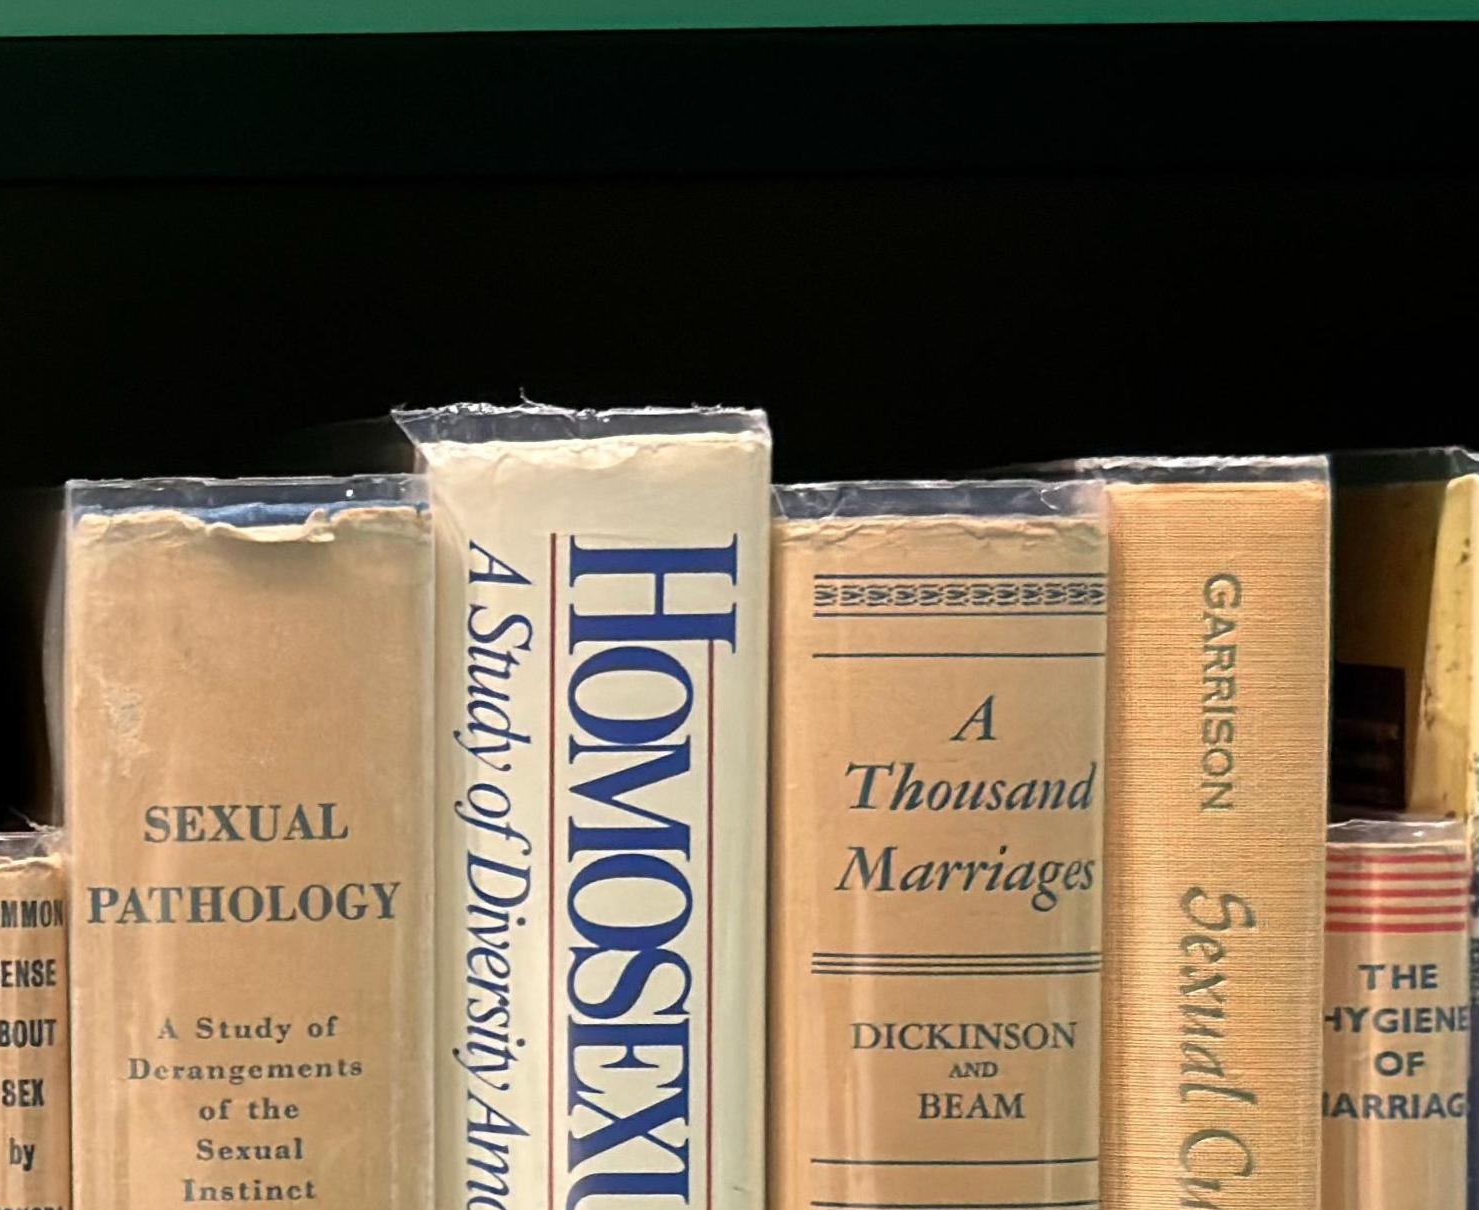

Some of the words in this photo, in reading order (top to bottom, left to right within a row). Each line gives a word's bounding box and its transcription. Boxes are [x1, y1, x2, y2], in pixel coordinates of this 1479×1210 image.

[453, 604, 533, 772] Study
[1199, 572, 1243, 814] GARRISON
[949, 694, 998, 742] A
[845, 761, 1097, 811] Thousand
[144, 802, 348, 843] SEXUAL
[834, 845, 1095, 912] Marriages
[87, 882, 400, 924] PATHOLOGY
[452, 850, 532, 1092] Diversity
[1357, 963, 1438, 991] THE
[1178, 884, 1259, 1105] Sexual
[157, 1018, 179, 1039] A
[196, 1017, 292, 1044] Study
[308, 1017, 338, 1038] of
[850, 1021, 1077, 1050] DICKINSON
[128, 1058, 364, 1085] Derangements
[949, 1061, 999, 1078] AND
[1374, 1051, 1425, 1077] OF
[2, 1079, 44, 1107] SEX
[918, 1092, 1025, 1119] BEAM
[198, 1099, 232, 1120] of
[249, 1098, 299, 1119] the
[9, 1138, 34, 1170] by
[196, 1138, 303, 1161] Sexual
[183, 1178, 316, 1201] Instinct
